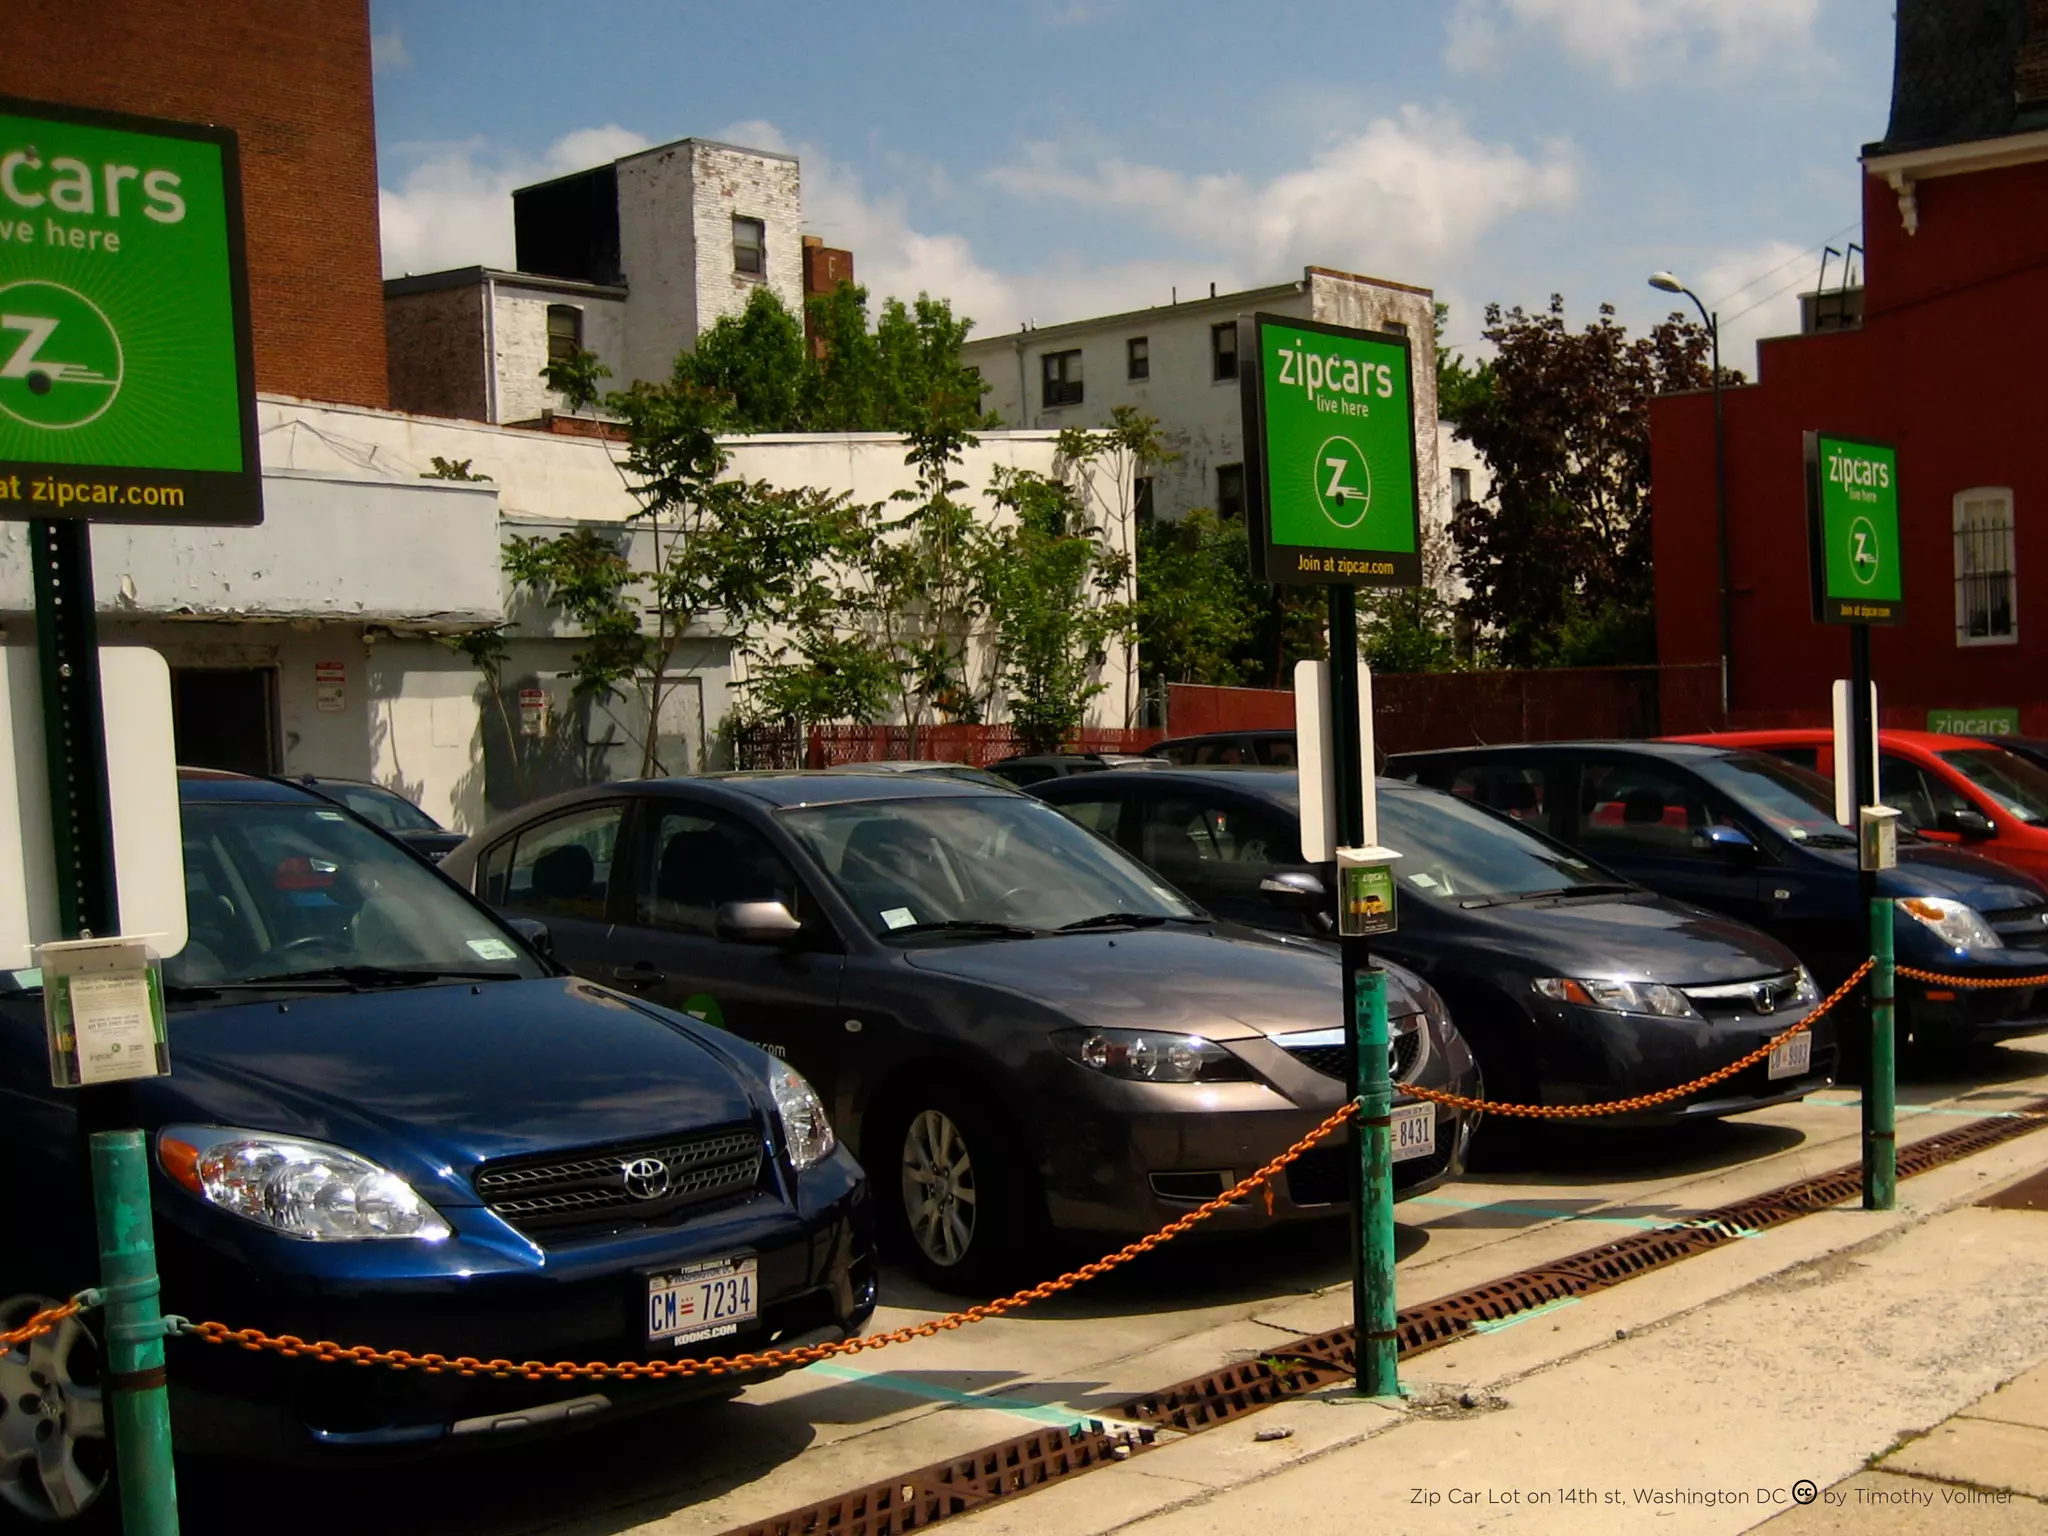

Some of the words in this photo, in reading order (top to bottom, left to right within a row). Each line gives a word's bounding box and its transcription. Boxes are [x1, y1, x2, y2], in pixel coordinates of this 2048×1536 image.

[0, 152, 187, 224] cars
[46, 218, 121, 252] here
[1278, 338, 1394, 401] zipcars
[1316, 394, 1338, 414] live
[1341, 397, 1369, 418] here
[1828, 447, 1890, 493] zipcars
[31, 475, 185, 508] zipcar.com
[1297, 553, 1321, 571] Join
[1323, 556, 1335, 572] at
[1337, 556, 1394, 576] zipcar.com
[1400, 1117, 1429, 1147] 8431
[651, 1291, 677, 1331] CM
[701, 1276, 751, 1321] 7234
[674, 1323, 737, 1347] KOONS.COM
